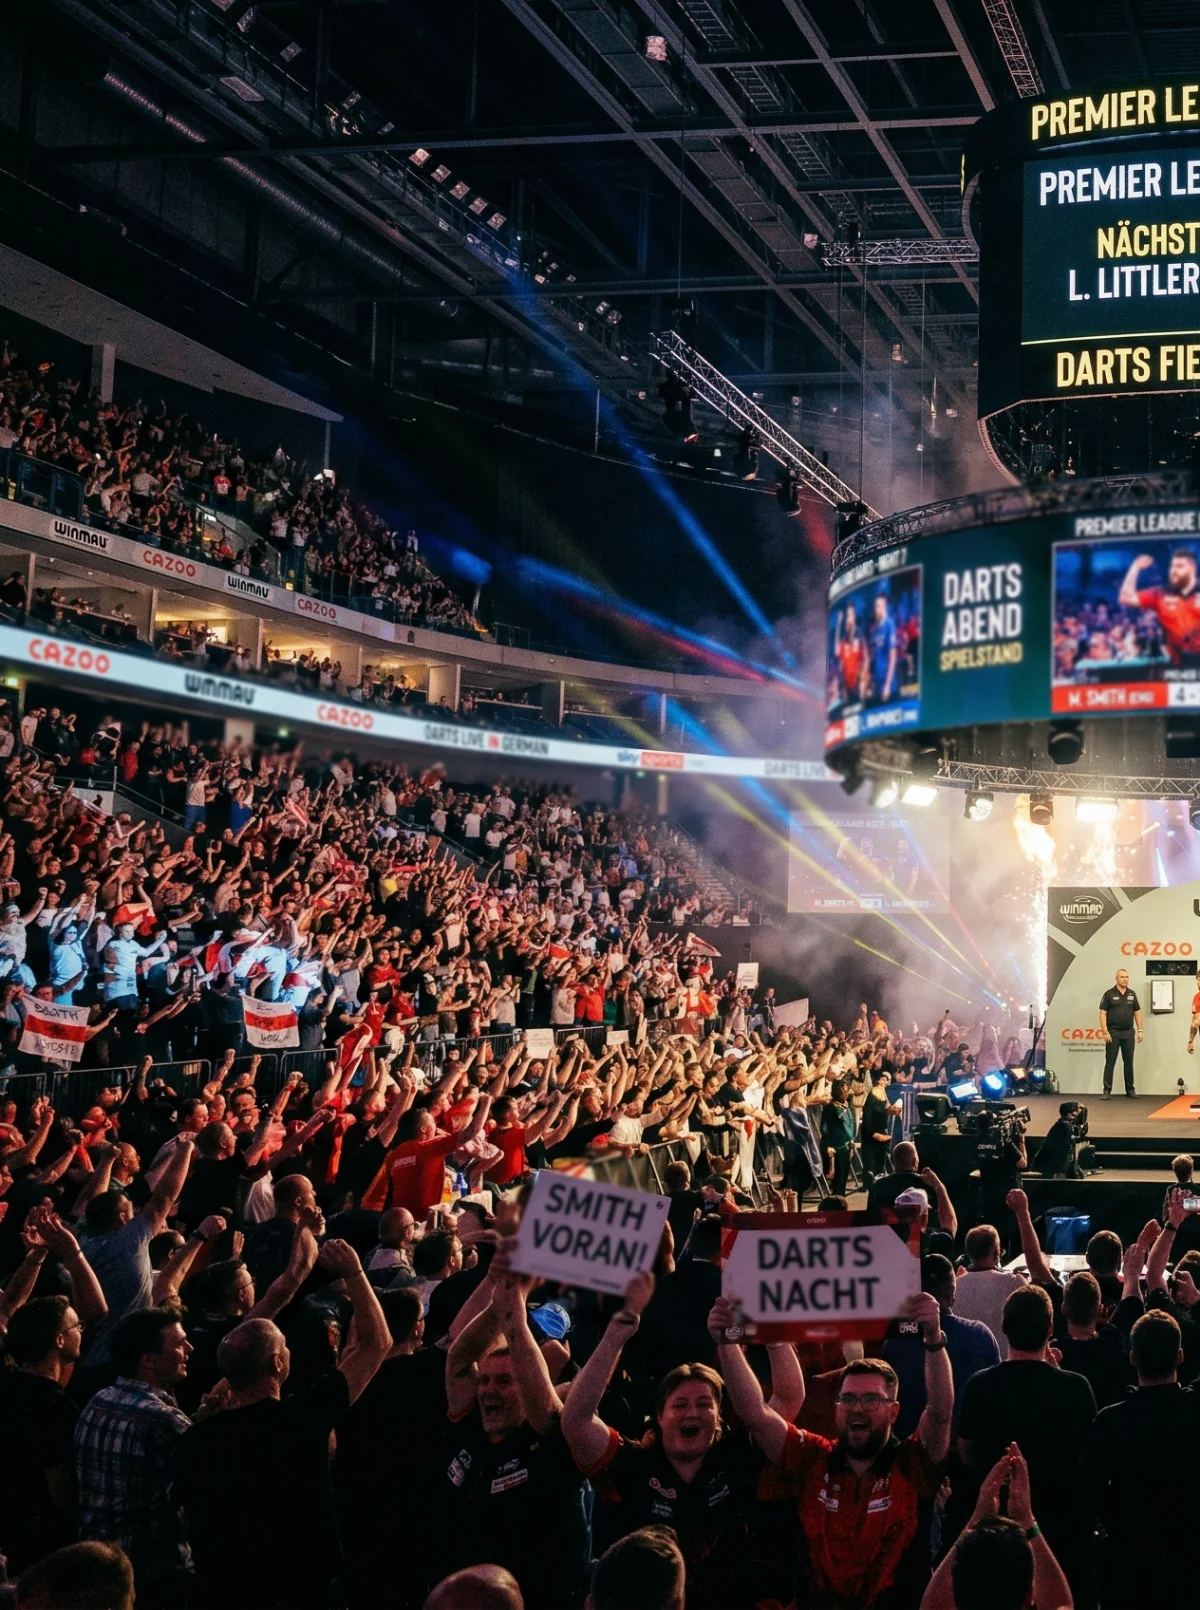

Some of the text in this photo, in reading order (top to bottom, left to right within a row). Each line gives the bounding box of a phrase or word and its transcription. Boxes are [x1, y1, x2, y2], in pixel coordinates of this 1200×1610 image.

[1032, 90, 1155, 140] PREMIER
[1041, 163, 1161, 205] PREMIER
[1070, 270, 1090, 301] L.
[1099, 263, 1199, 298] LITTLER
[1057, 347, 1150, 387] DARTS
[54, 520, 107, 549] WINMAU
[1075, 516, 1137, 536] PREMIER
[1140, 512, 1195, 532] LEAGUE
[143, 550, 196, 577] CAZOO
[227, 575, 269, 599] WINMAU
[944, 563, 1022, 607] DARTS
[297, 598, 337, 619] CAZOO
[942, 602, 1022, 647] ABEND
[28, 638, 111, 675] CAZOO
[940, 641, 1023, 672] SPIELSTAND
[185, 673, 254, 706] WINMAU
[1174, 686, 1186, 703] 4
[317, 704, 374, 730] CAZOO
[424, 723, 459, 745] DARTS
[461, 730, 484, 748] LIVE
[502, 734, 549, 756] GERMAN
[1120, 941, 1193, 956] CAZOO
[1061, 1028, 1105, 1040] CAZO
[545, 1182, 647, 1232] SMITH
[532, 1218, 649, 1272] VORAN!
[758, 1235, 873, 1270] DARTS
[759, 1277, 880, 1312] NACHT
